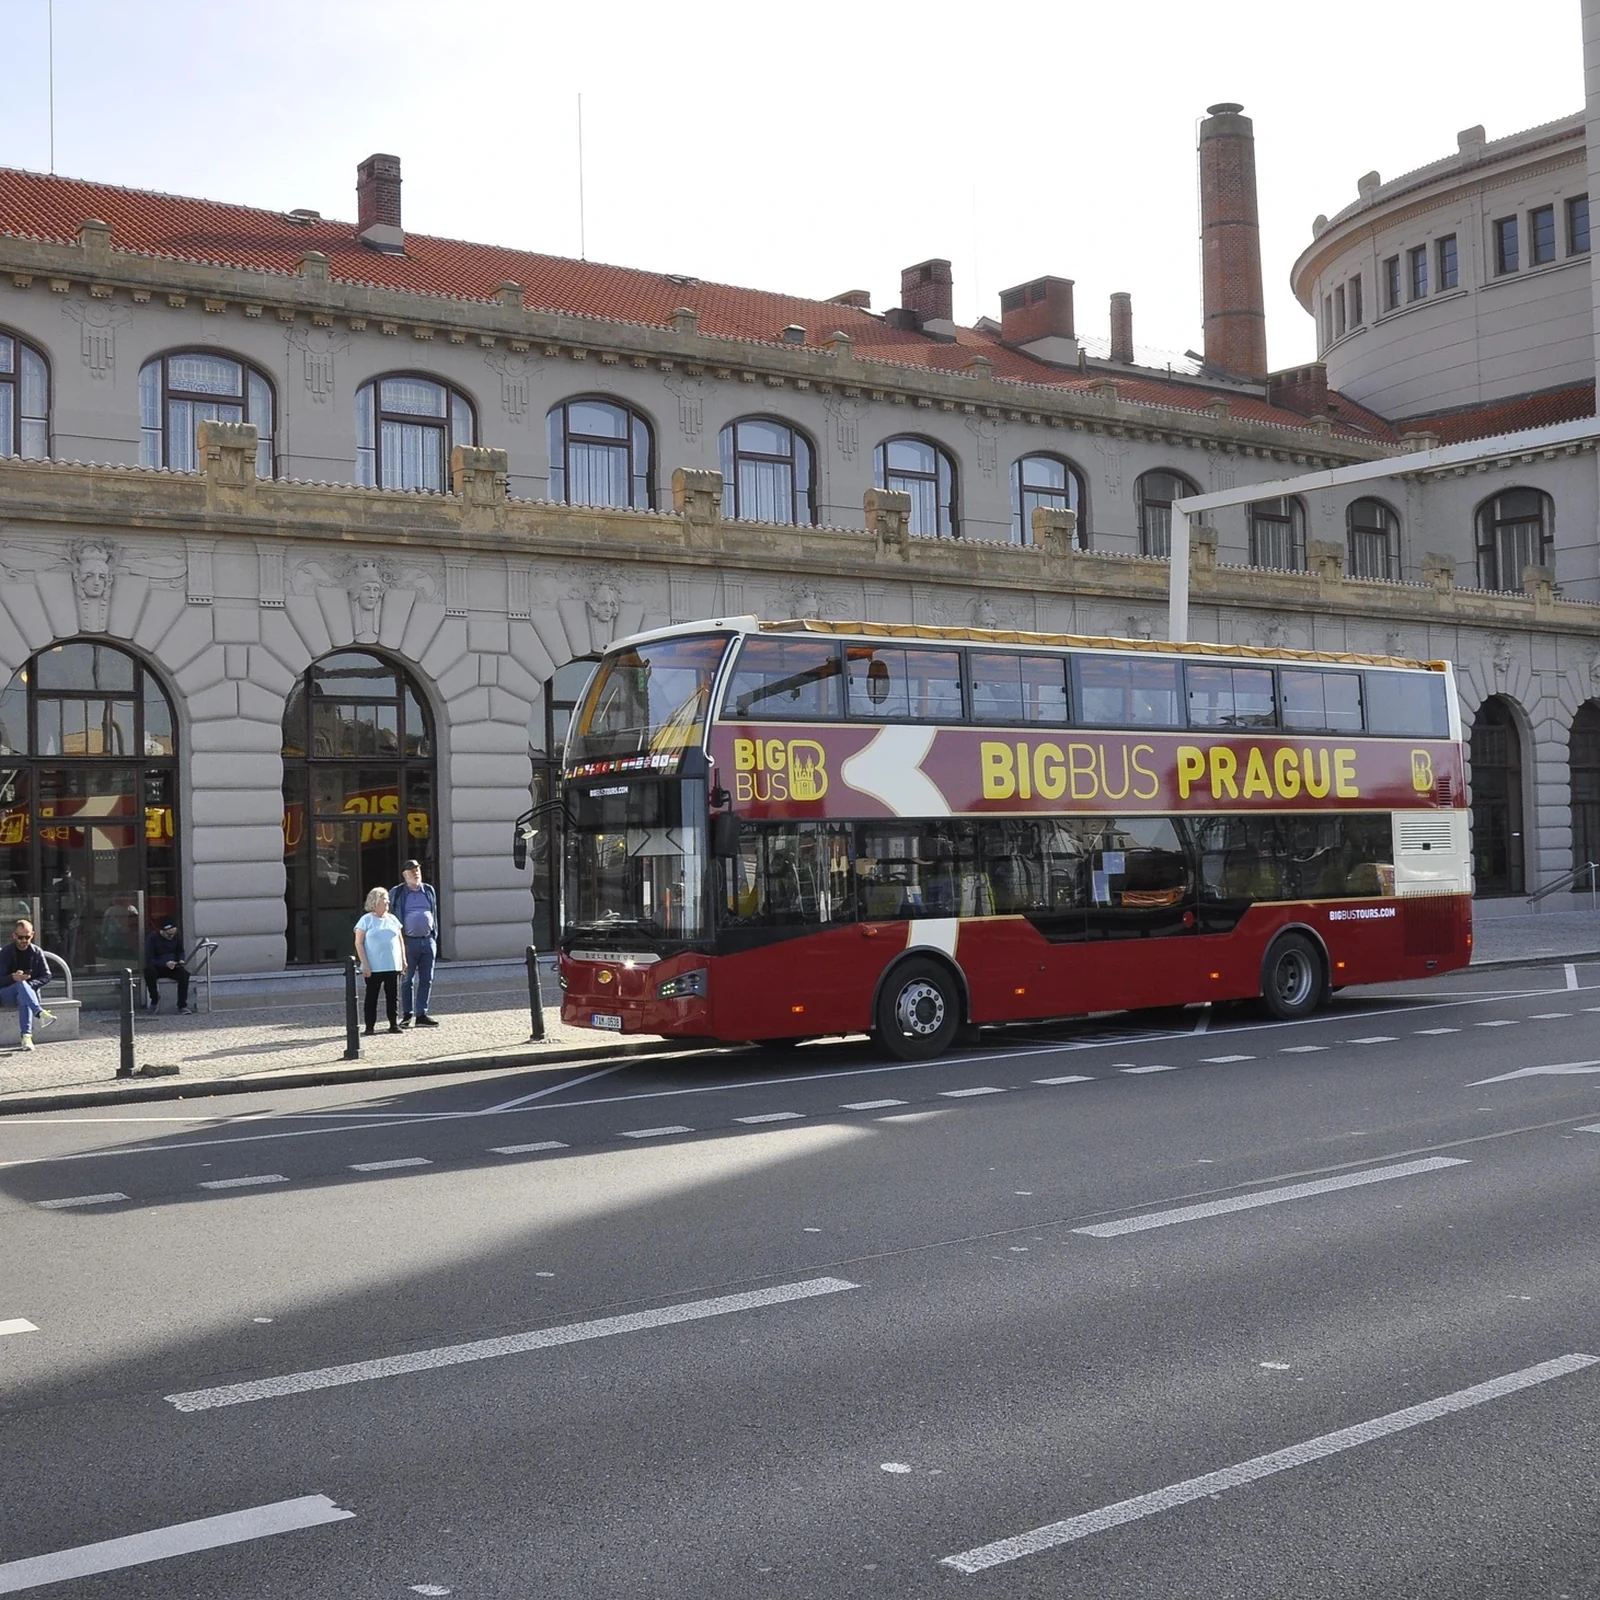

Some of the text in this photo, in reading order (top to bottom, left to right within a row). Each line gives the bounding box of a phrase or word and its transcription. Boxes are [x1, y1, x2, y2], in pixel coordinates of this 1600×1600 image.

[734, 739, 786, 770] BIG
[736, 773, 788, 802] BUS
[1177, 745, 1360, 800] PRAGUE
[1329, 908, 1396, 921] BIGBUSTOURS.COM
